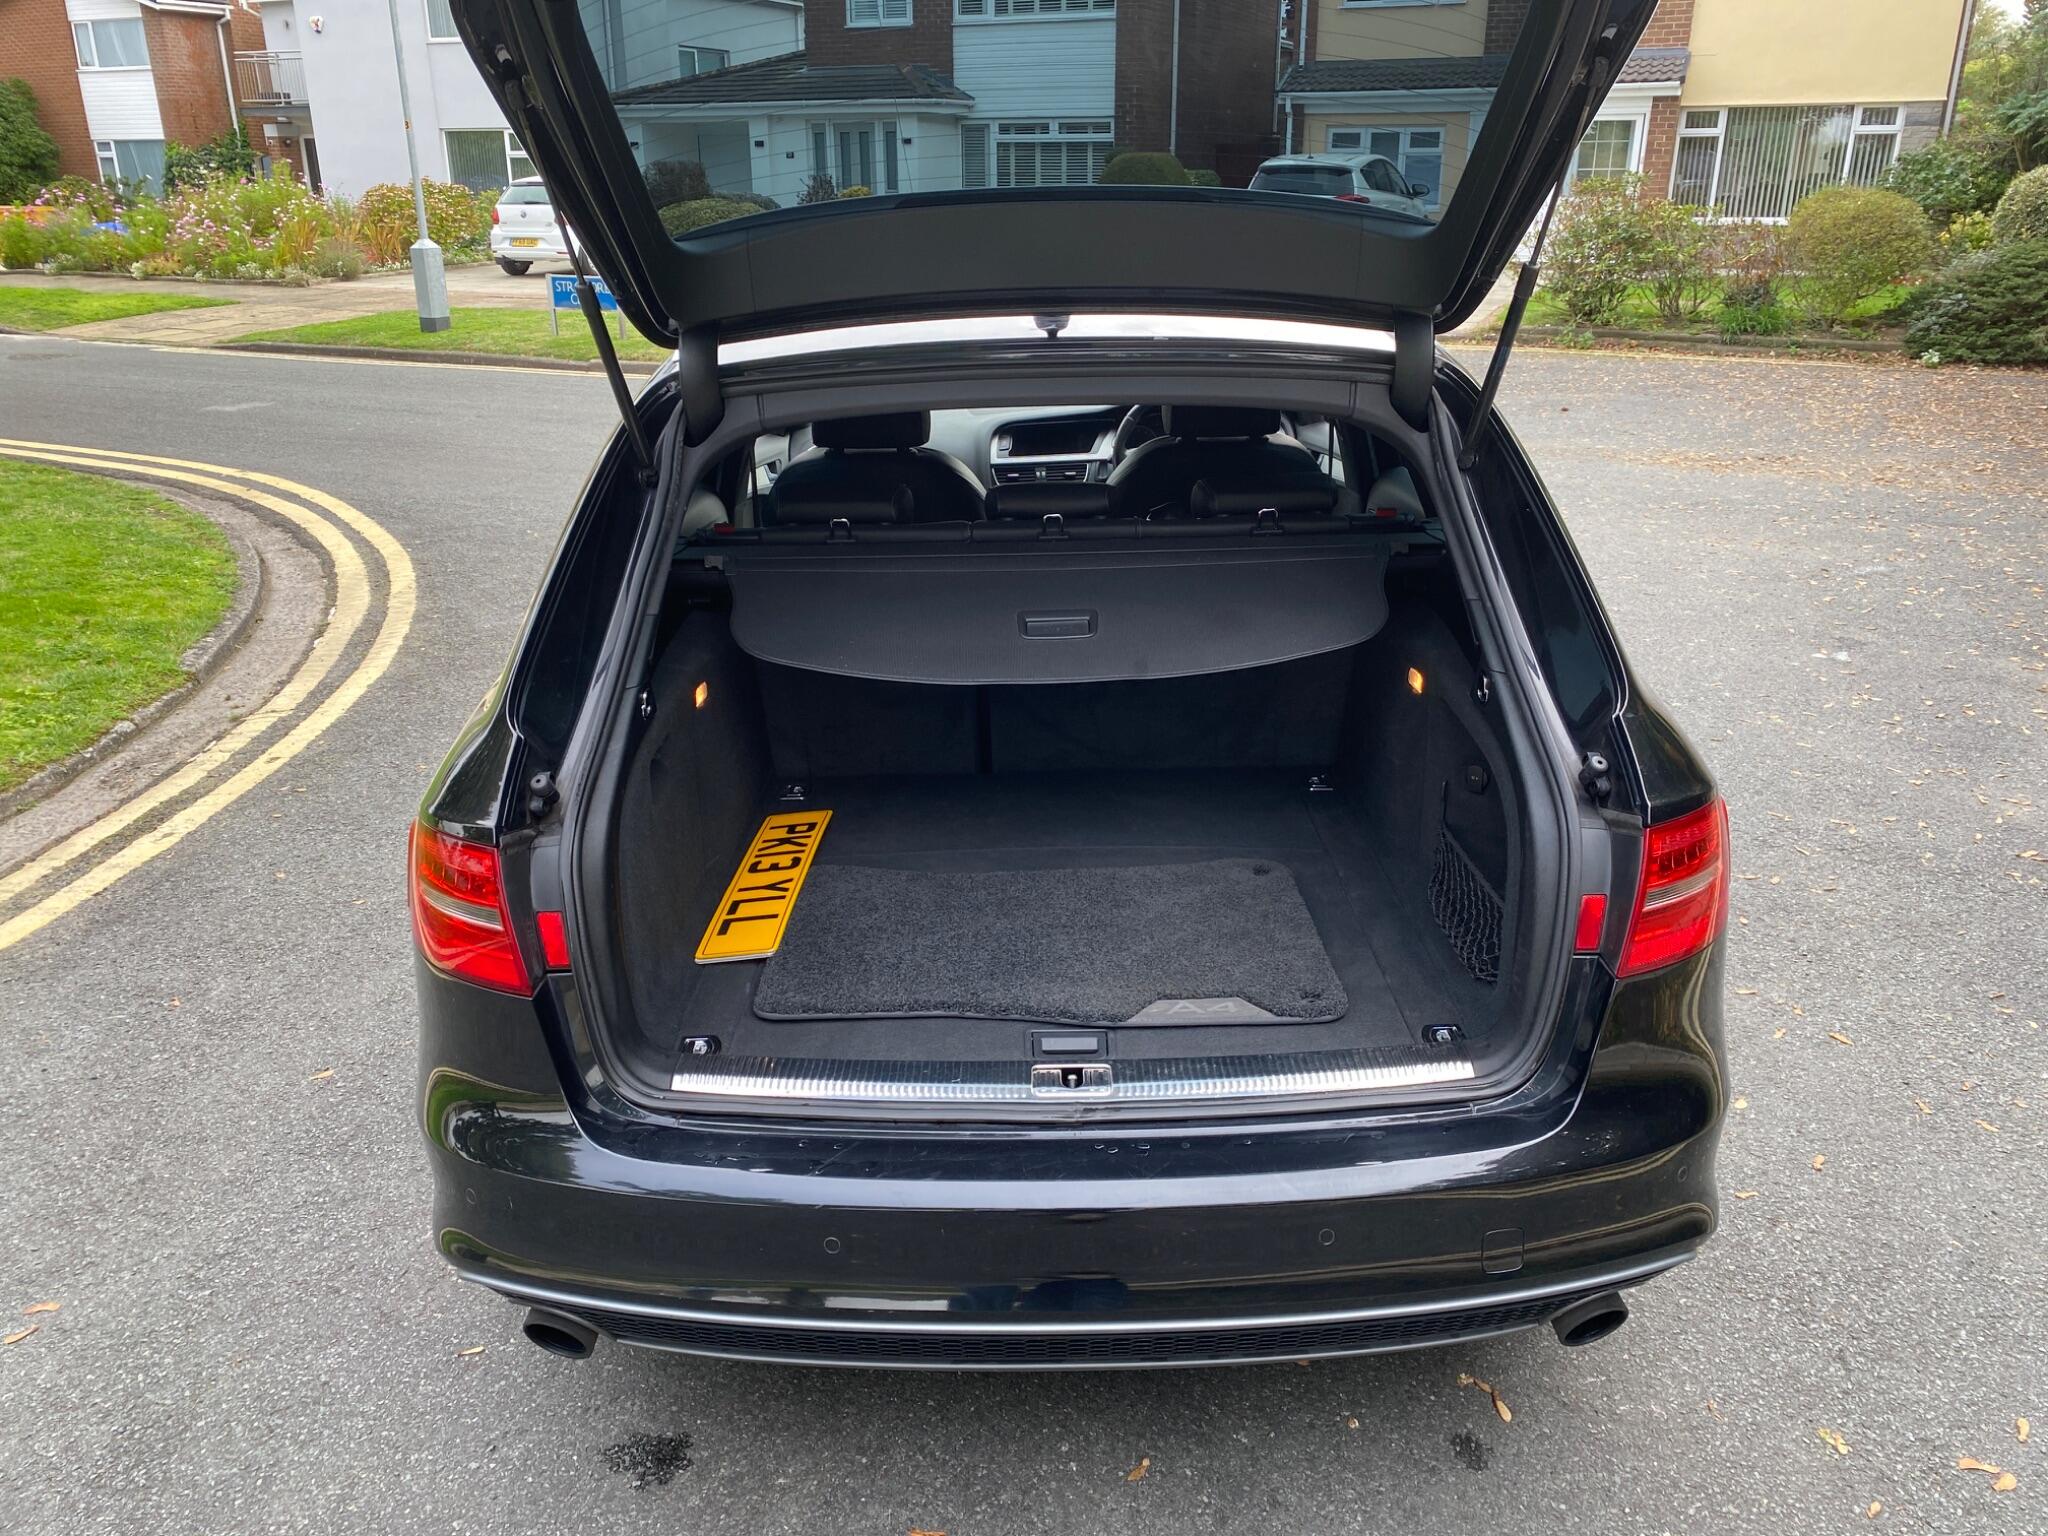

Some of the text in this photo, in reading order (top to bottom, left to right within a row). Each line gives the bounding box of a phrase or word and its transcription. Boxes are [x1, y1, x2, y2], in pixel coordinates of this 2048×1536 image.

[555, 280, 612, 294] STROR
[716, 821, 818, 936] PK13 YLL
[1166, 1000, 1238, 1014] A4
